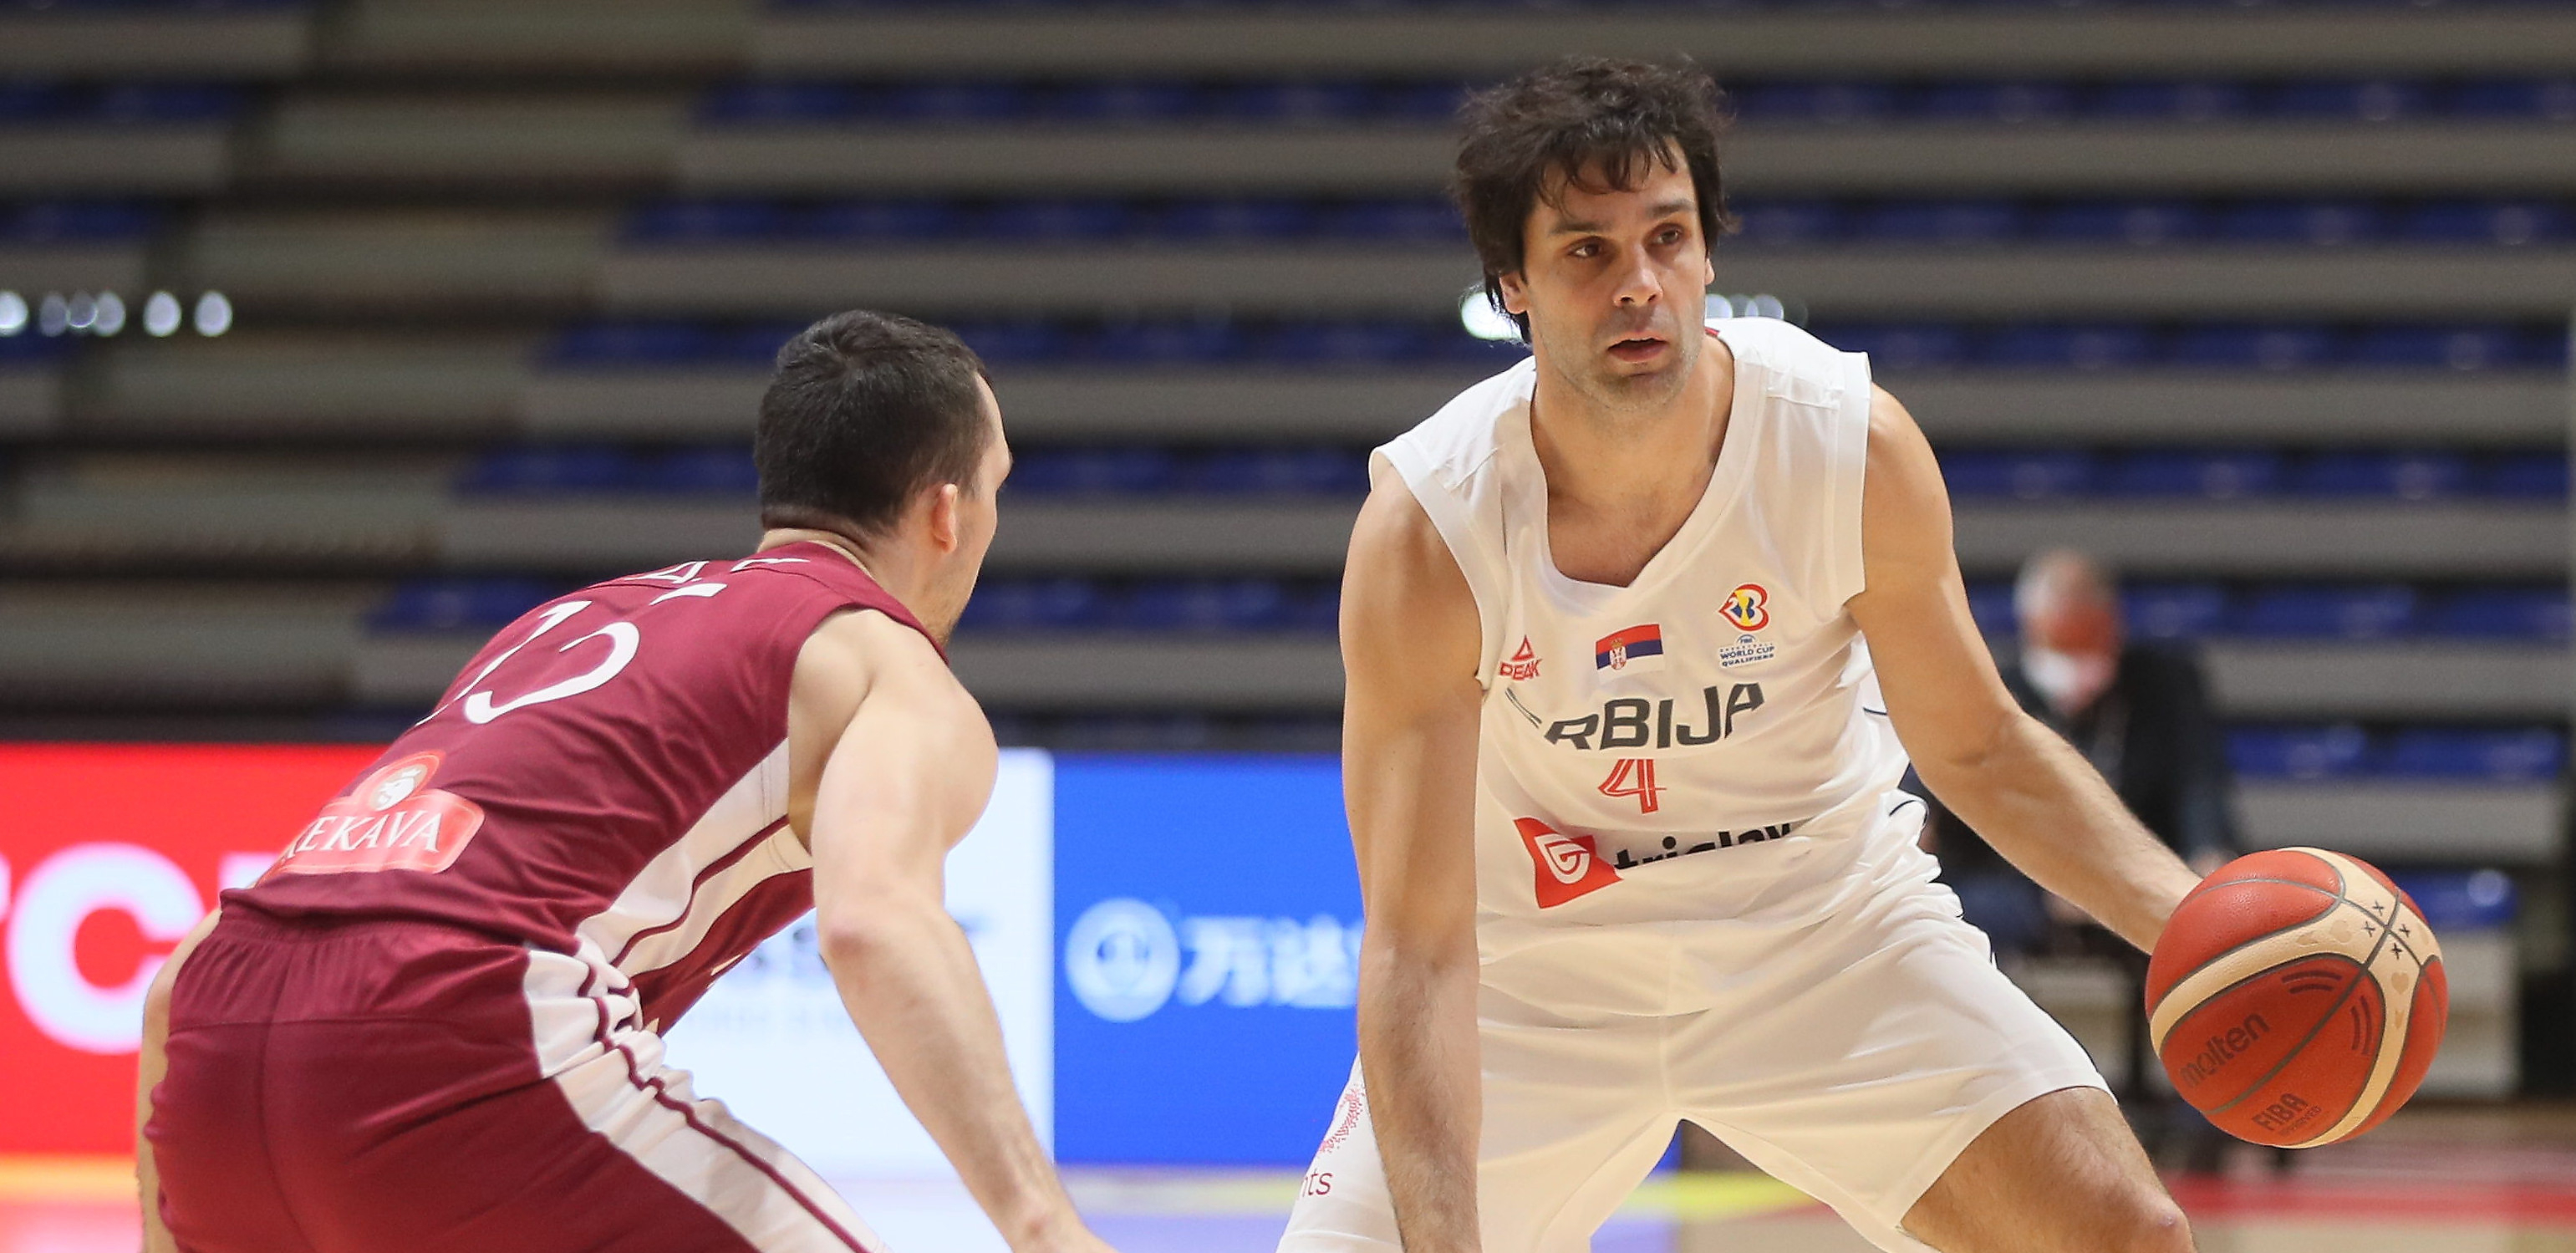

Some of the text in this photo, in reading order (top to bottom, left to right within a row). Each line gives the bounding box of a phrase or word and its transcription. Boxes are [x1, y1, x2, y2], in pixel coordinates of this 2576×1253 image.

[1720, 649, 1754, 660] WORLD
[1504, 682, 1765, 751] RBIJA
[1597, 758, 1667, 814] 4
[2179, 1013, 2270, 1086] molten
[2252, 1093, 2309, 1131] FIBA
